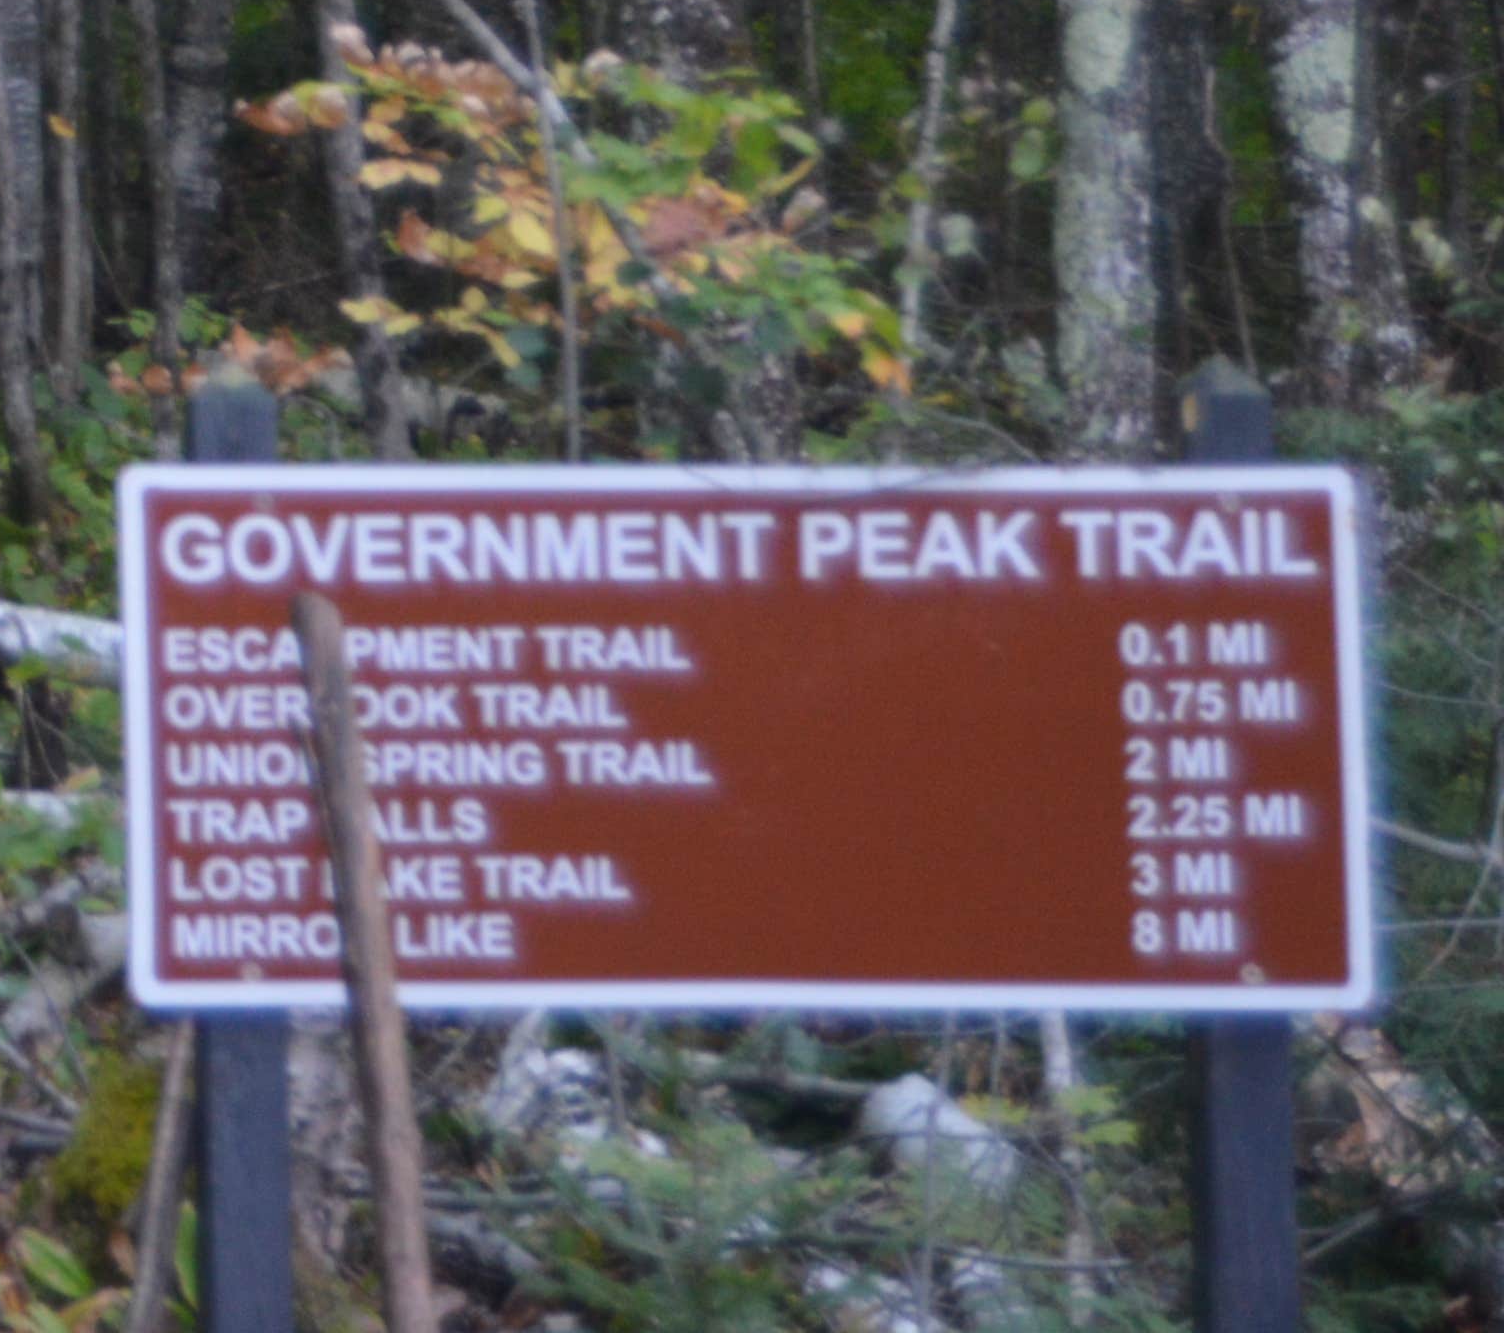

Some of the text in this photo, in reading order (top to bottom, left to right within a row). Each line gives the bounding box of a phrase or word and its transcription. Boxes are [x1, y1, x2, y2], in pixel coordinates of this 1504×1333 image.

[161, 509, 1319, 583] GOVERNMENT PEAK TRAIL
[165, 626, 692, 672] ESCAPMENT TRAIL
[1118, 622, 1267, 666] 0.1 MI
[165, 683, 627, 728] OVEROOK TRAIL
[1120, 679, 1297, 723] 0.75 MI
[556, 740, 715, 784] TRAIL
[1124, 737, 1228, 781] 2 MI
[166, 798, 487, 844] TRAP LLS
[1126, 794, 1304, 838] 2.25 MI
[171, 855, 309, 901] LOST
[474, 855, 631, 901] TRAIL
[1130, 852, 1233, 896] 3 MI
[172, 913, 515, 959] MIRRO LIKE
[1132, 910, 1235, 954] 8 MI
